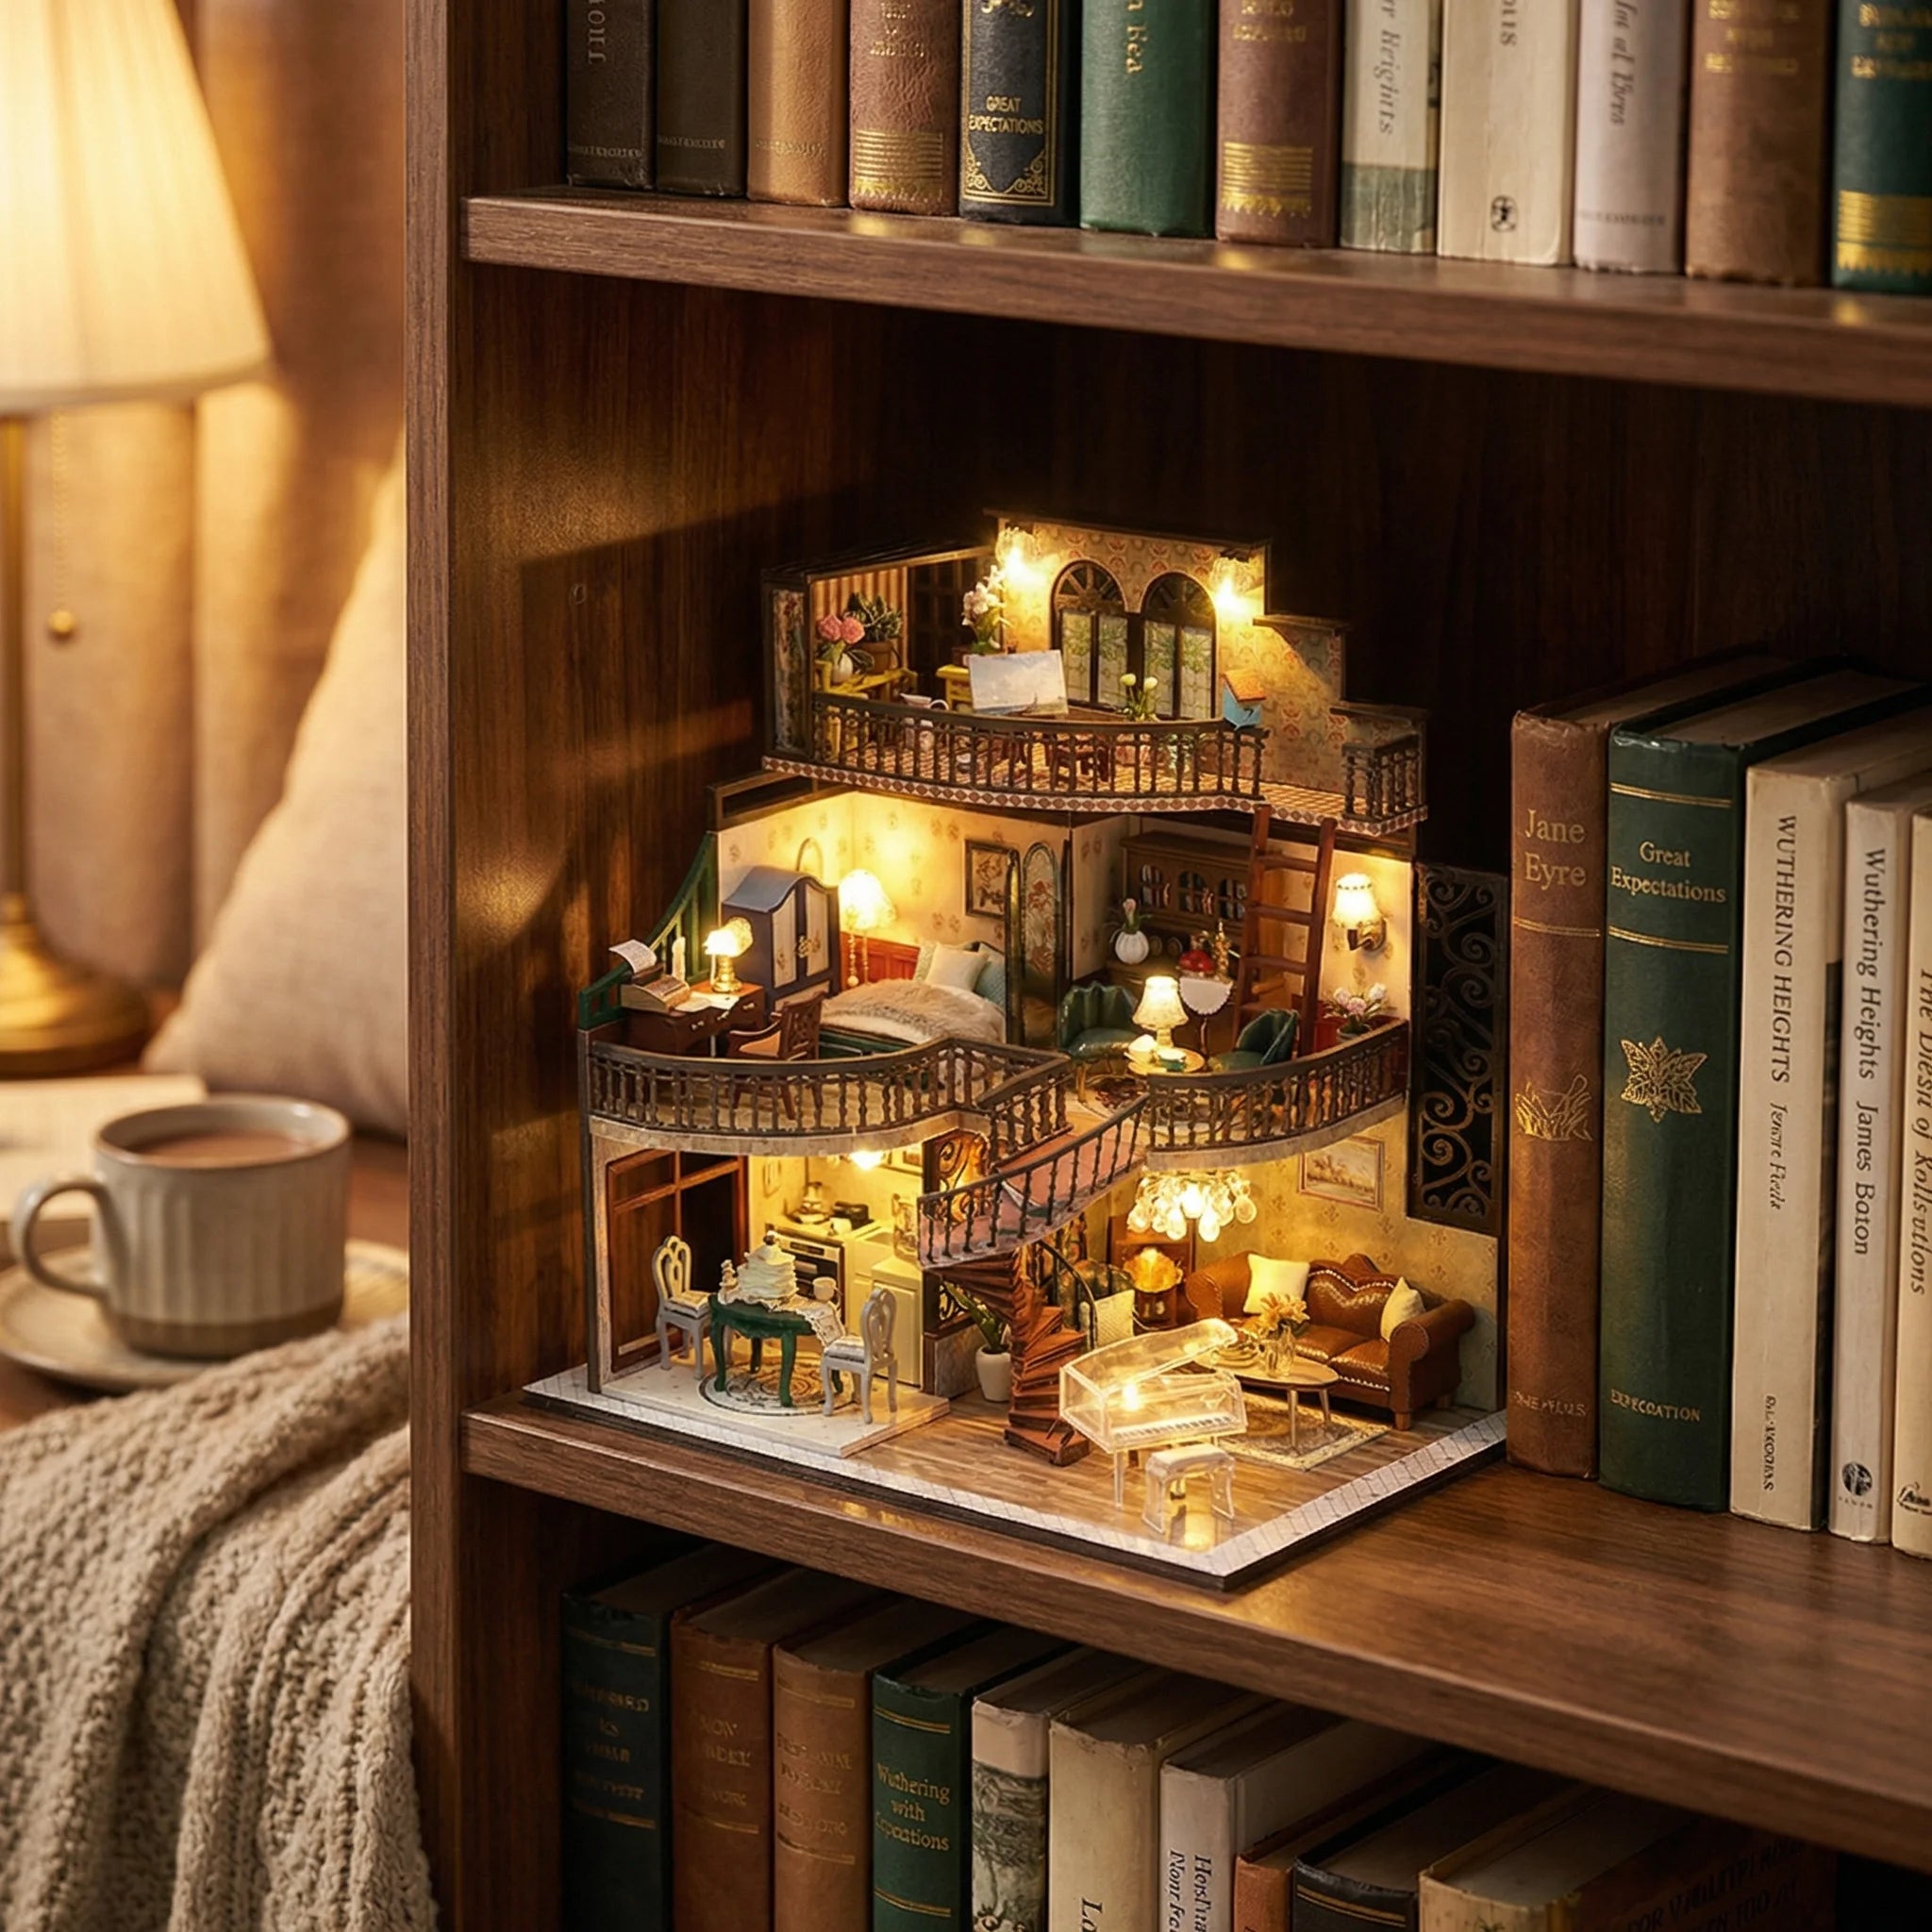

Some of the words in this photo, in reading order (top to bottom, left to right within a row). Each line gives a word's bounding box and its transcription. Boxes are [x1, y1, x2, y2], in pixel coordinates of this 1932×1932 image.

[985, 96, 1022, 112] GREAT
[1524, 808, 1586, 844] Jane
[1524, 851, 1587, 891] Eyre
[1639, 841, 1691, 868] Great
[1610, 865, 1726, 903] Expectations
[1774, 815, 1797, 968] WUTHERING
[1856, 847, 1887, 979] Wuthering
[1771, 974, 1792, 1084] HEIGHTS
[1853, 986, 1882, 1080] Heights
[1856, 1100, 1879, 1172] James
[876, 1762, 951, 1806] Wuthering
[891, 1799, 926, 1823] with
